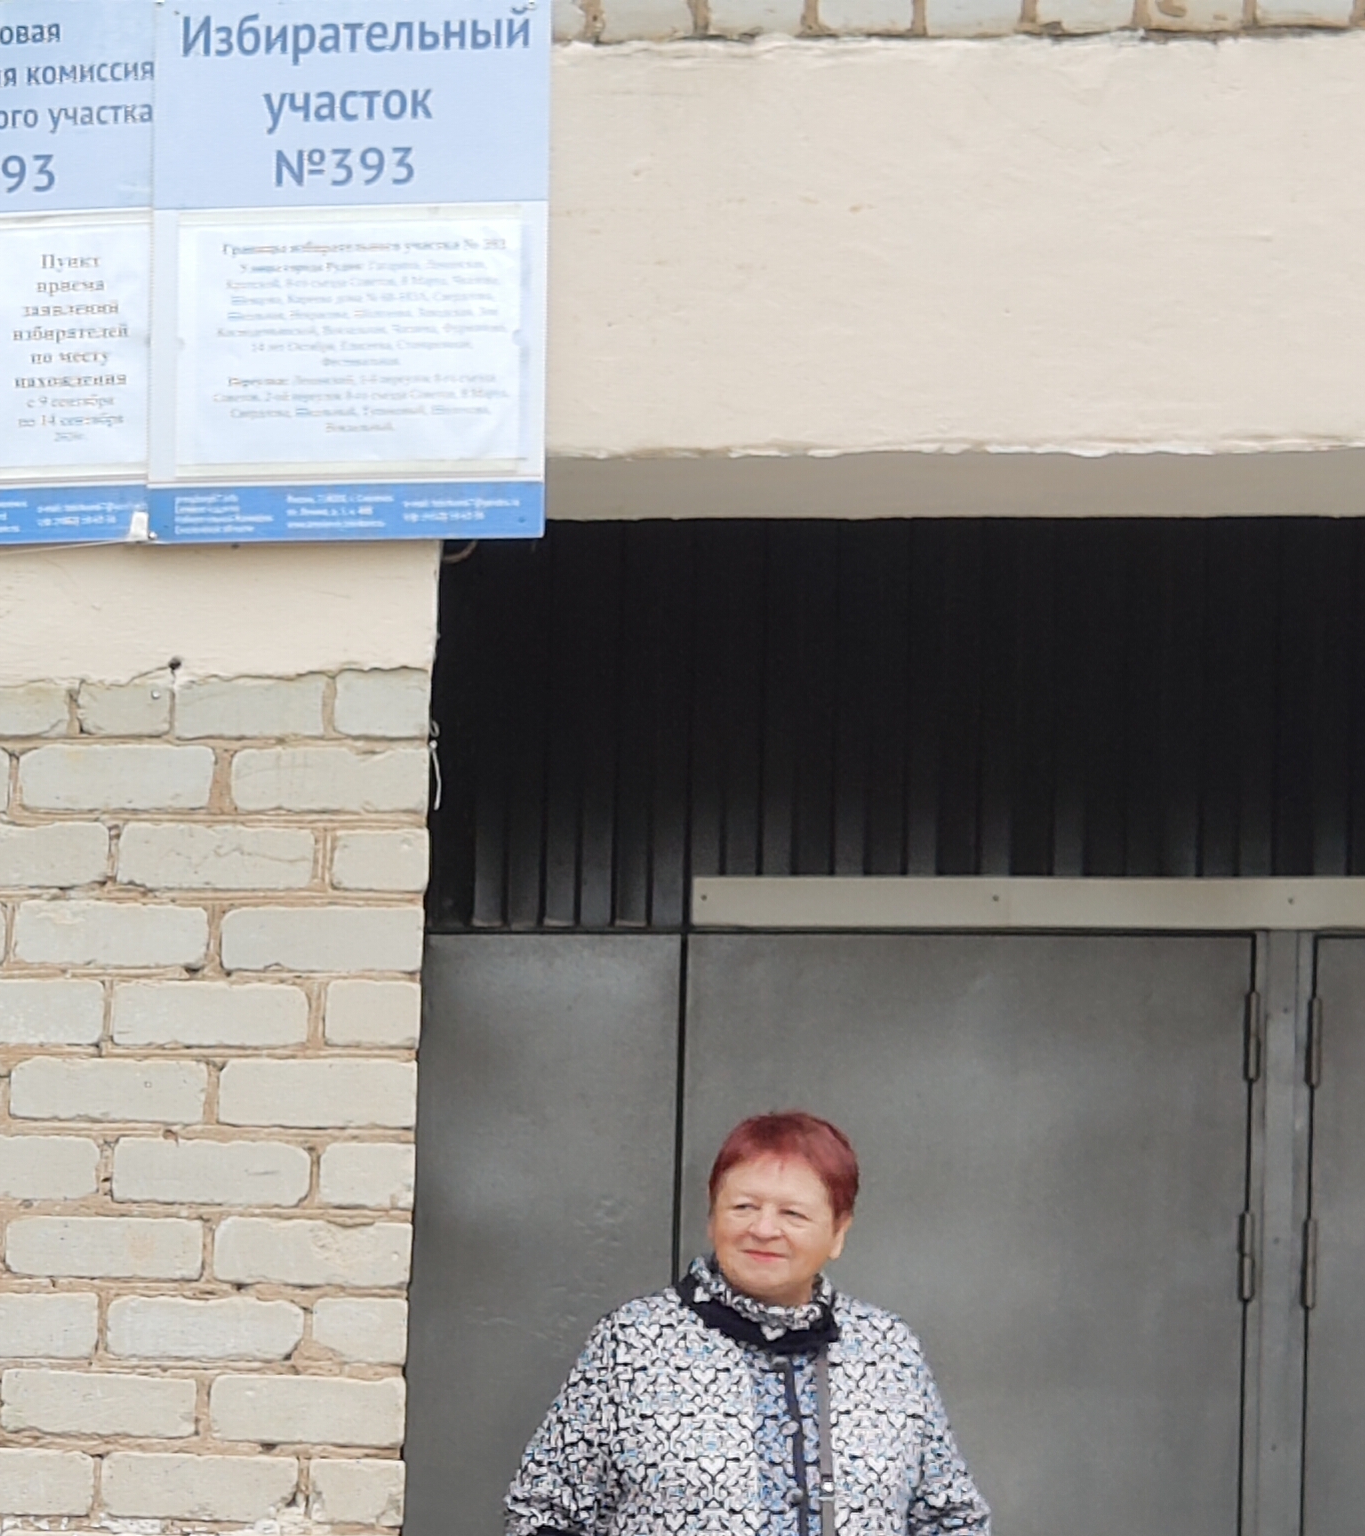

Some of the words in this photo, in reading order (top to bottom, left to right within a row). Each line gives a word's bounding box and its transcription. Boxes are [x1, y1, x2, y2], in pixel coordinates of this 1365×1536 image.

[181, 4, 531, 66] Избирательный
[26, 60, 155, 87] комиссия
[48, 102, 154, 134] участка
[262, 88, 433, 135] участок
[274, 146, 415, 187] №393
[41, 254, 102, 273] Пункт
[13, 323, 129, 344] избирателей
